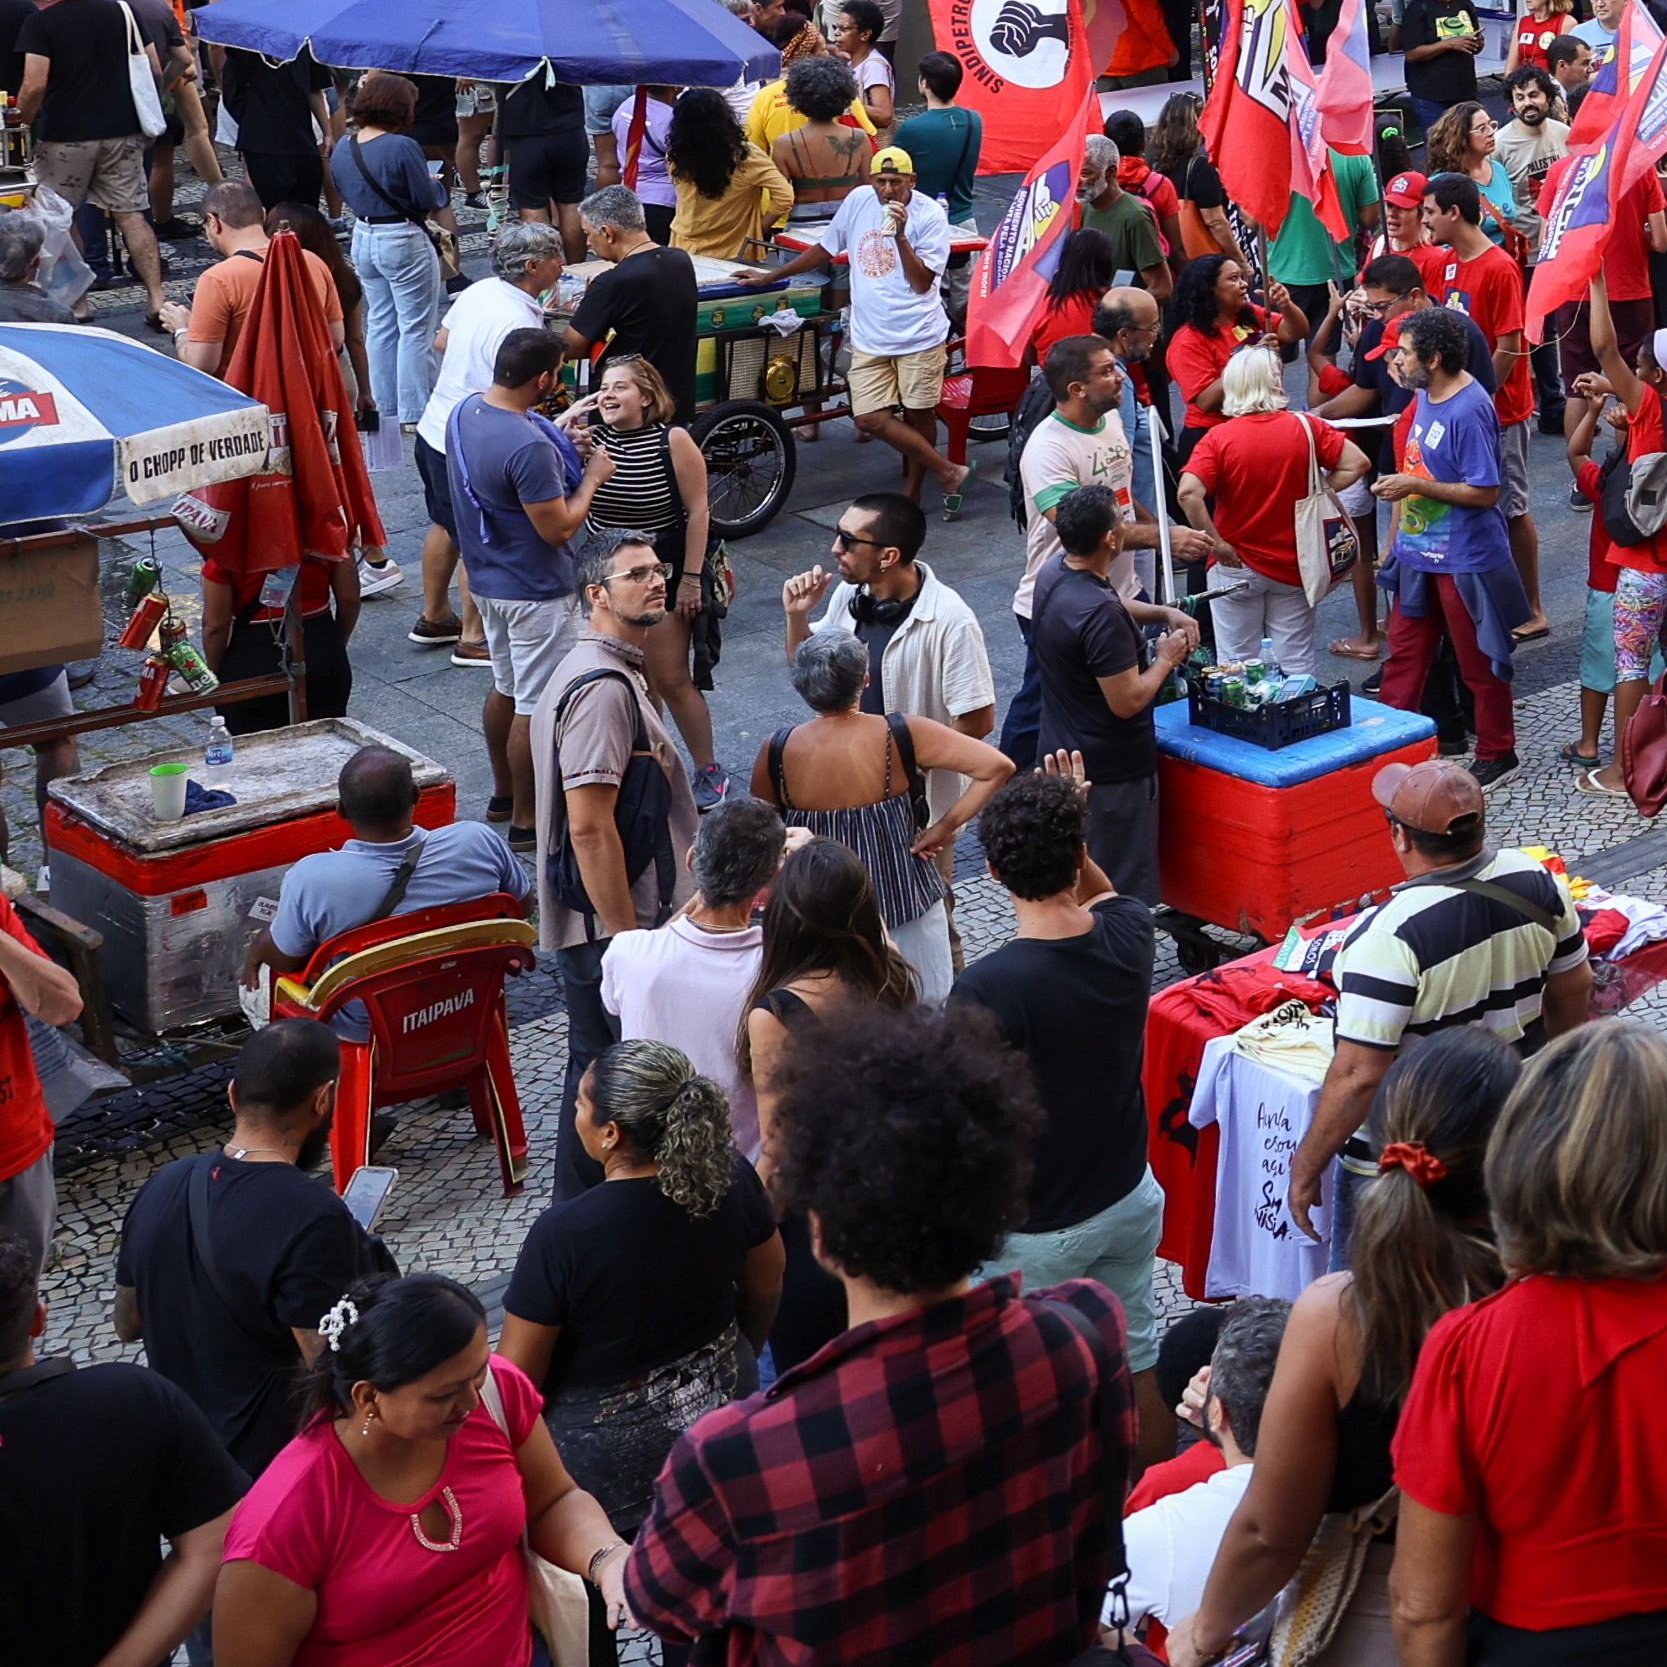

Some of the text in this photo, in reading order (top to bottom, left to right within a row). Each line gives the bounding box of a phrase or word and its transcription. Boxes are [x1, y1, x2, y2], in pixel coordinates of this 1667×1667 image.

[1007, 190, 1028, 244] MOVIMENTO
[130, 431, 265, 483] O CHOPP DE VERDADE
[403, 988, 475, 1034] ITAIPAVA
